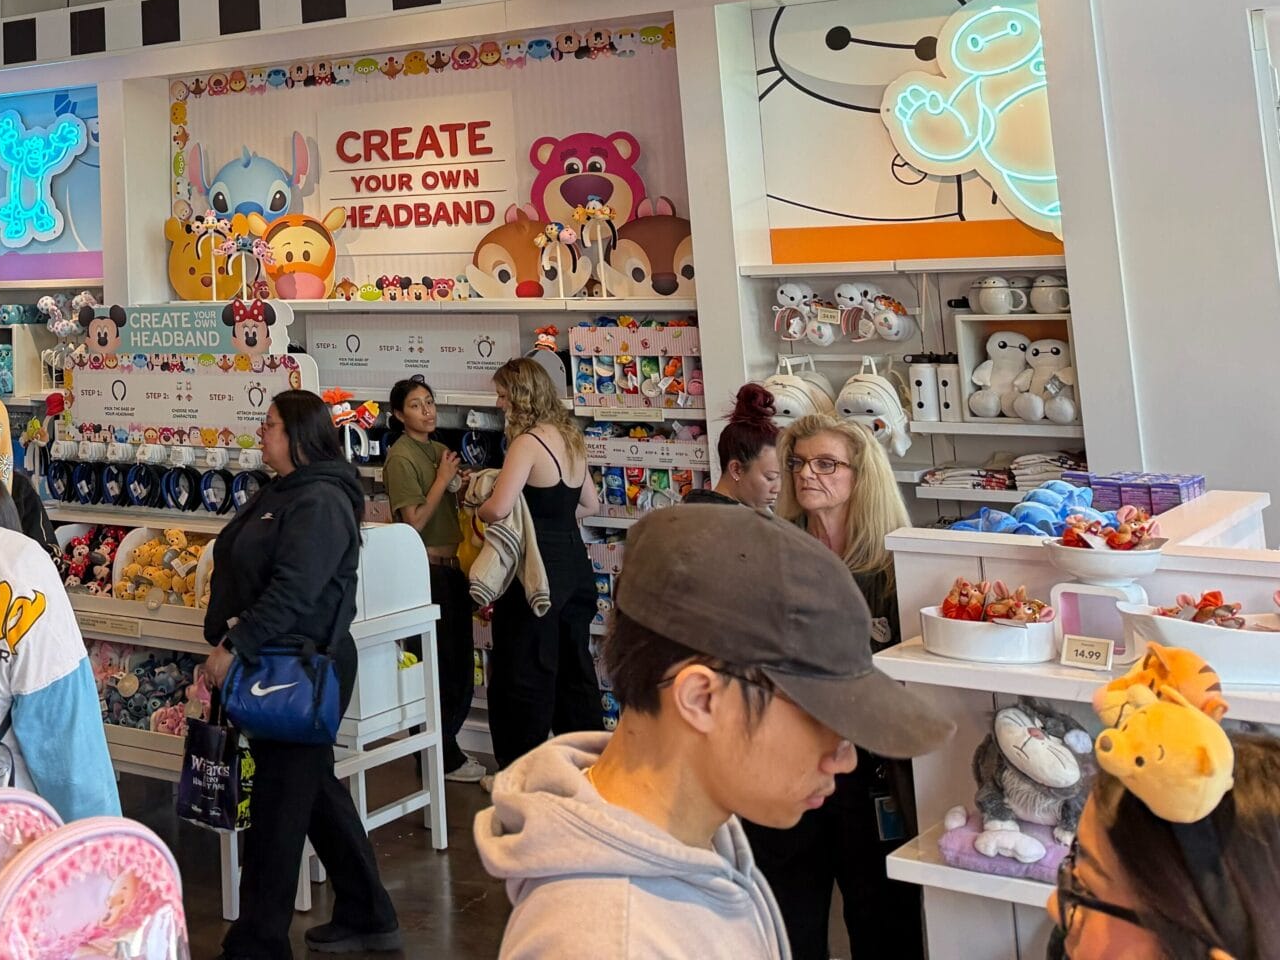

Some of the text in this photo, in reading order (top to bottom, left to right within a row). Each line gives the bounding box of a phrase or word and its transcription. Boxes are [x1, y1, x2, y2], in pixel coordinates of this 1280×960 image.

[336, 120, 493, 163] CREATE
[351, 169, 479, 193] YOUR OWN
[342, 200, 495, 228] HEADBAND
[129, 311, 217, 329] CREATE YOUR
[194, 320, 217, 328] OWN
[130, 331, 220, 347] HEADBAND
[1073, 648, 1102, 660] 14.99
